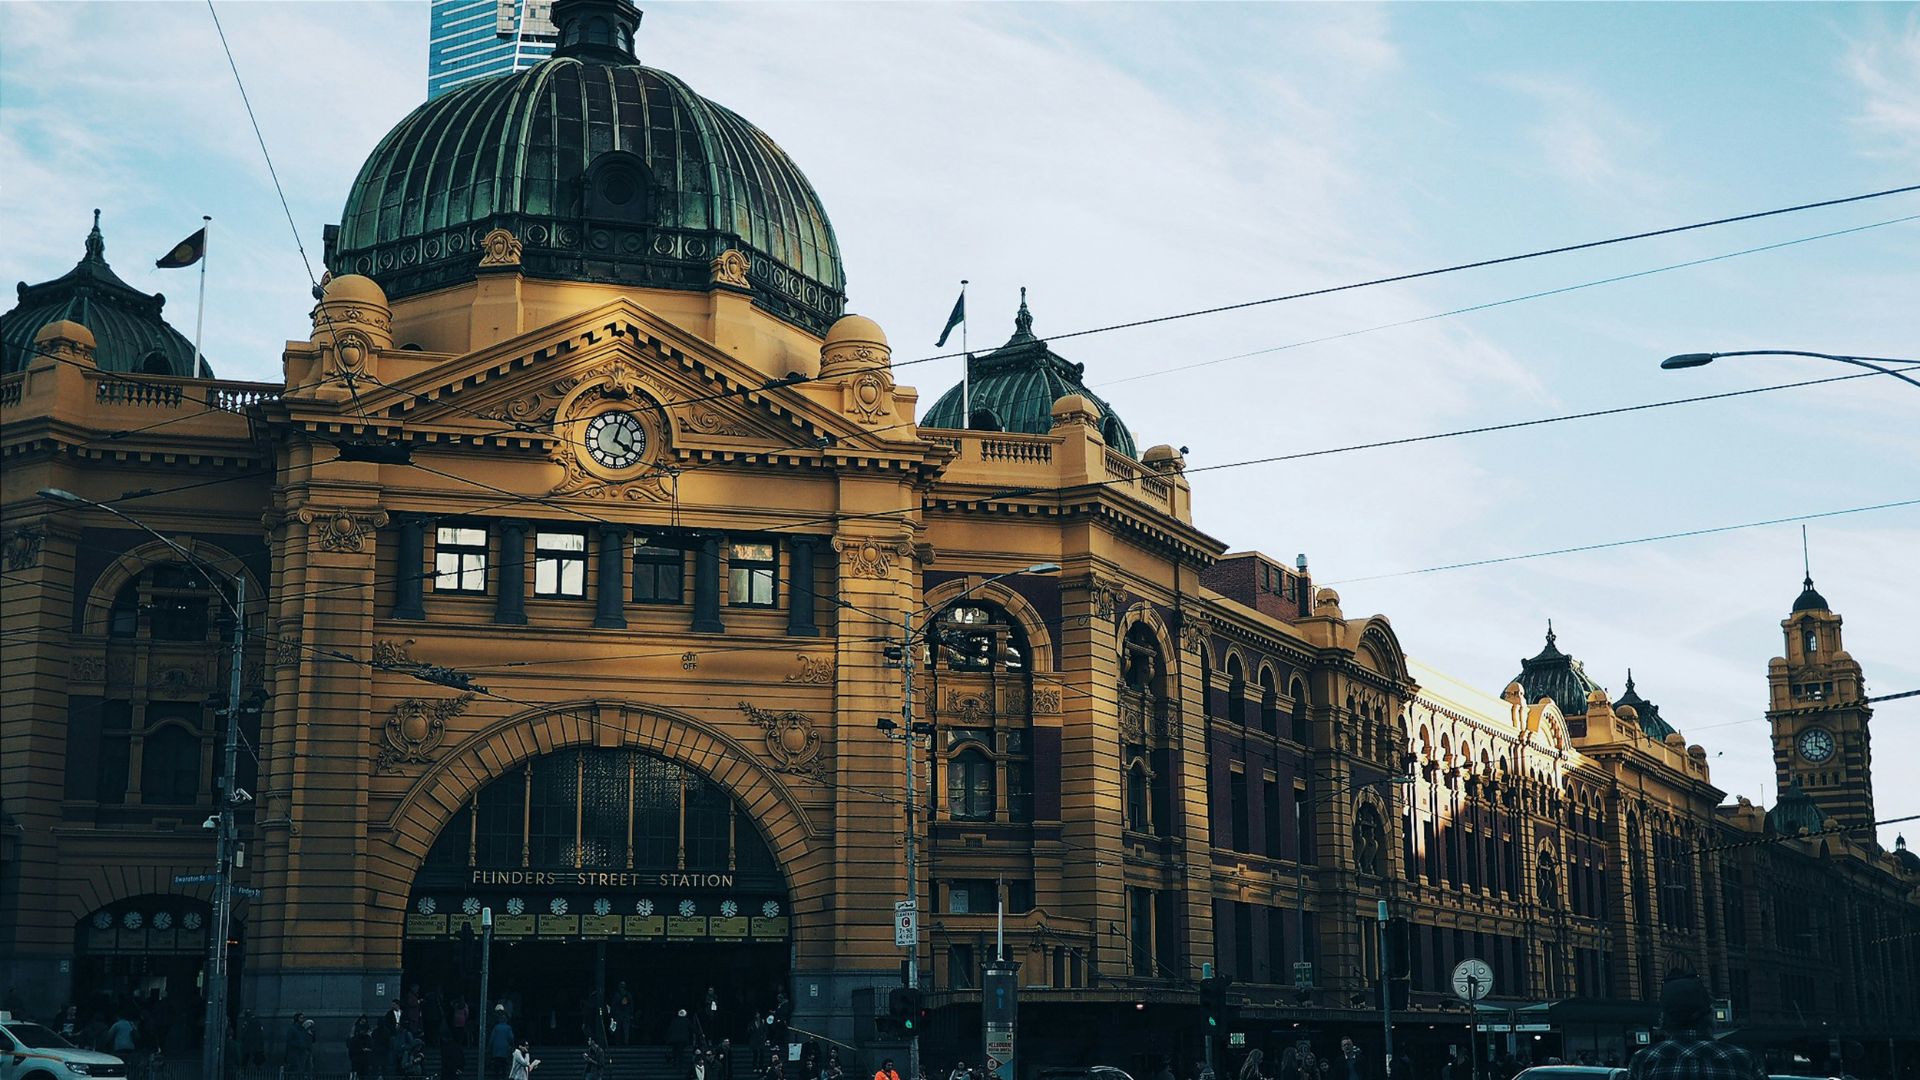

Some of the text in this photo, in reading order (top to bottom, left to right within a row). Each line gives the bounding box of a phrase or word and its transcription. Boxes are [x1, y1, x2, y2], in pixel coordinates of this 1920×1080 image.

[472, 870, 734, 888] FLINDERS STREET STATION
